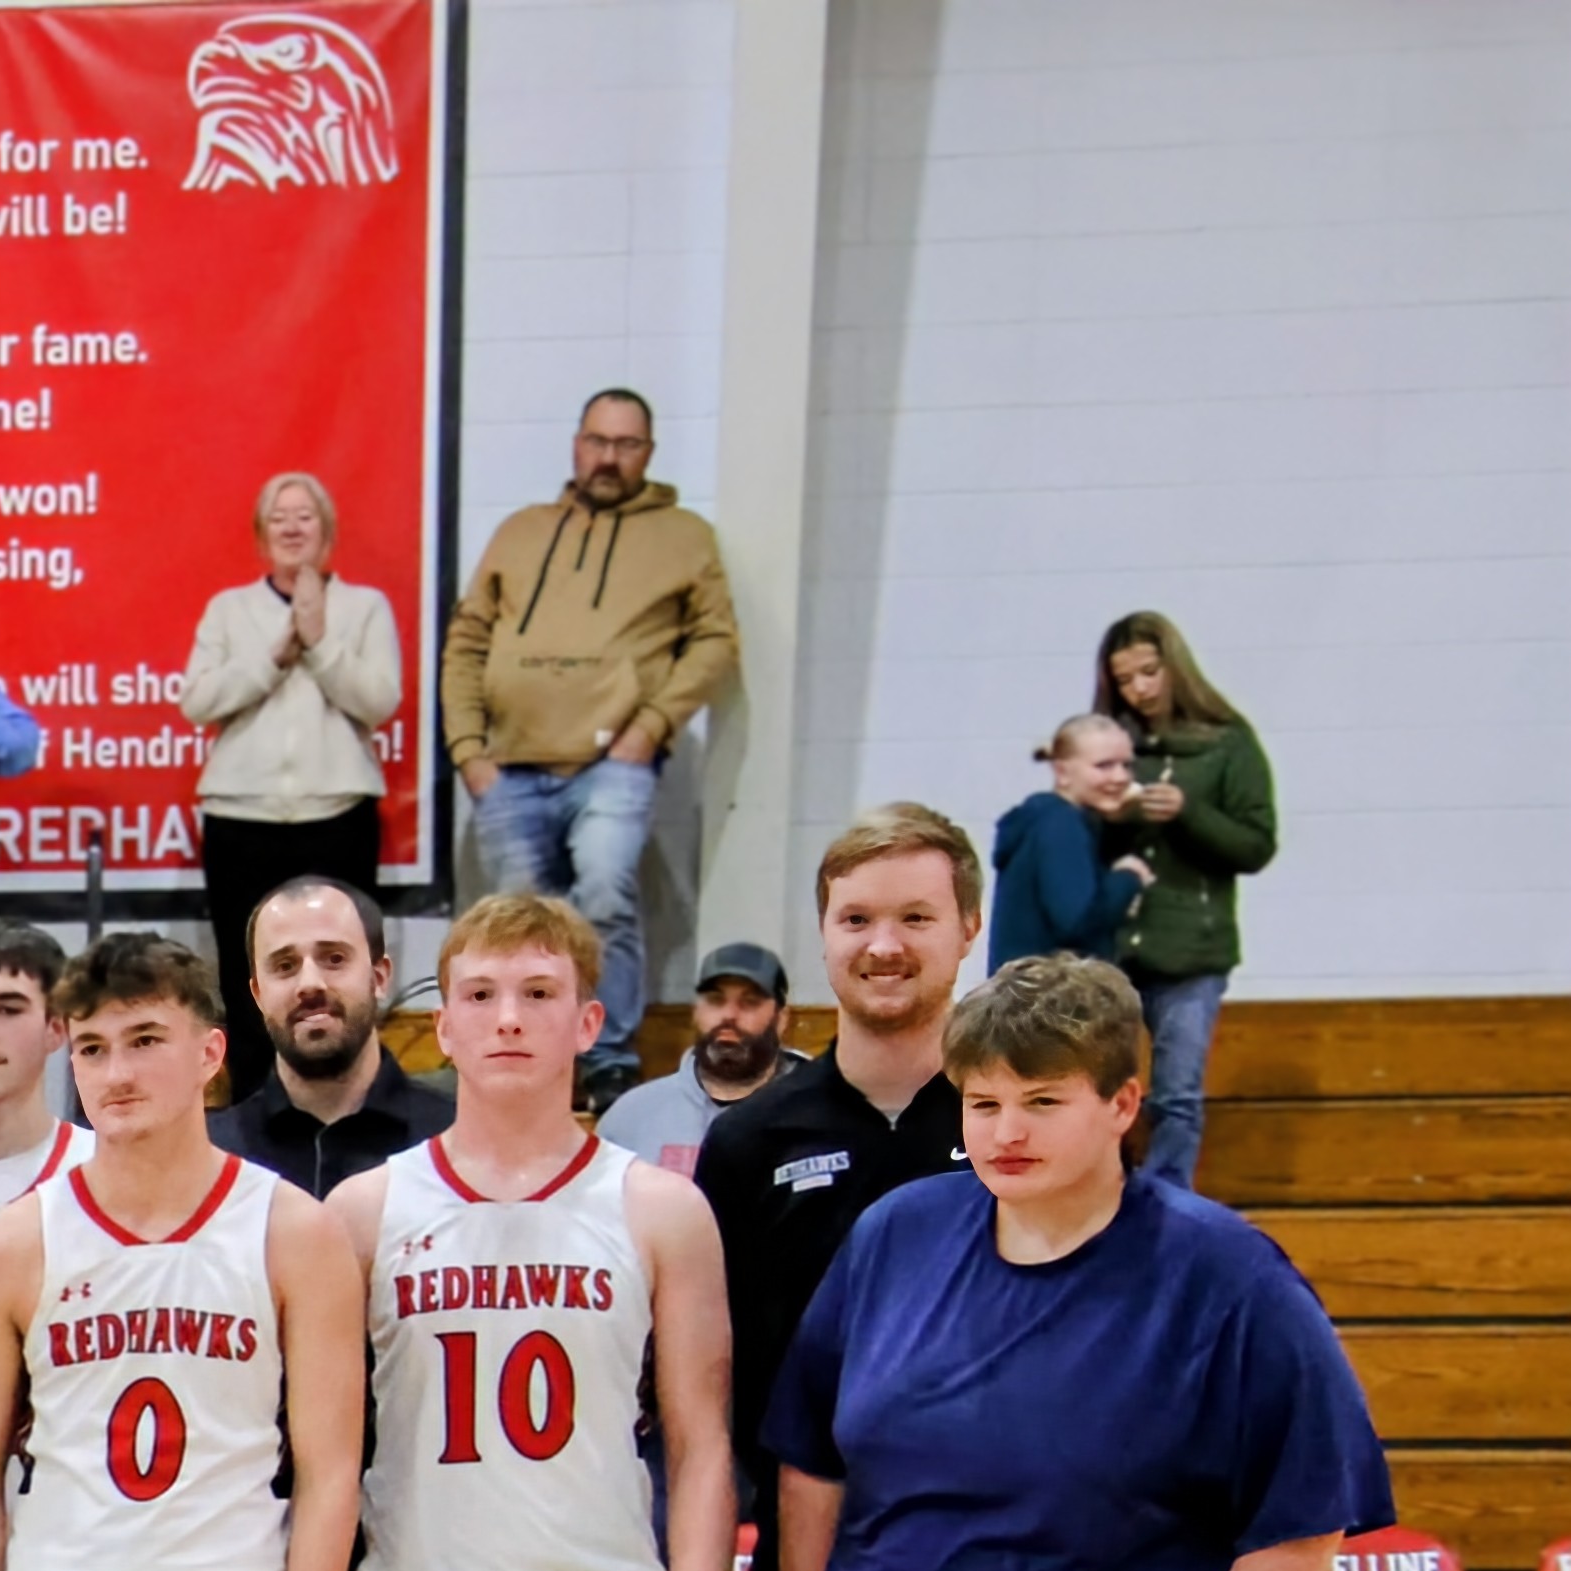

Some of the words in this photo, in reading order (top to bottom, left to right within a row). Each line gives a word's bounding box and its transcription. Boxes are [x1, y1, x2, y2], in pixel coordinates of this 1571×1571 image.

[71, 136, 149, 172] me.
[62, 190, 128, 237] be!
[30, 322, 149, 367] fame.
[20, 663, 100, 707] will
[109, 661, 185, 707] sho
[61, 723, 205, 770] Hendri
[395, 1264, 614, 1320] REDHAWKS
[48, 1308, 259, 1368] REDHAWKS
[434, 1329, 577, 1465] 10
[107, 1377, 188, 1503] 0
